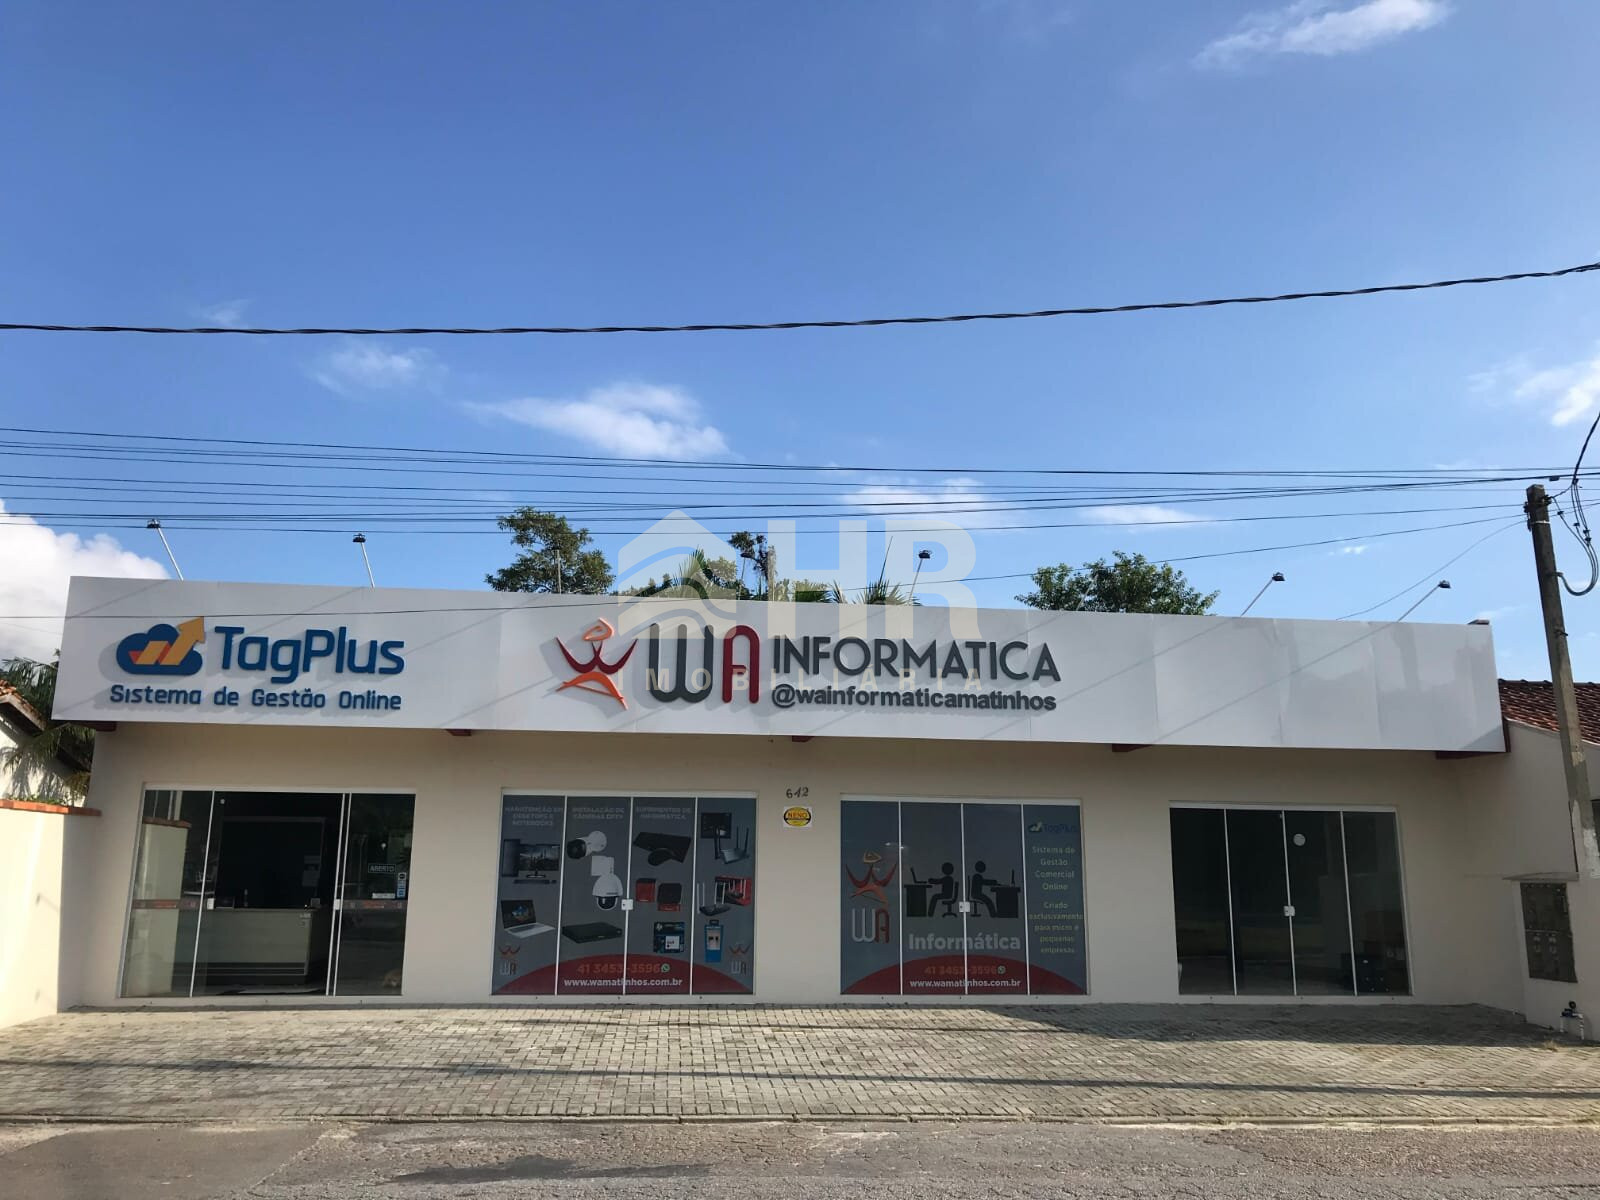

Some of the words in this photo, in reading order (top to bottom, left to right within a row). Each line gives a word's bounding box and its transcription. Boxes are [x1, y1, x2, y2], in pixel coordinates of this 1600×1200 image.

[214, 626, 405, 684] TagPlus
[649, 623, 761, 703] WA
[773, 634, 1062, 682] INFORMATICA
[110, 684, 202, 705] Sistema
[213, 686, 239, 706] de
[251, 688, 326, 709] Gestão
[338, 690, 402, 710] Online
[771, 683, 1057, 711] @wainformaticamatinhos
[852, 908, 890, 943] WA
[908, 931, 1021, 950] Informática
